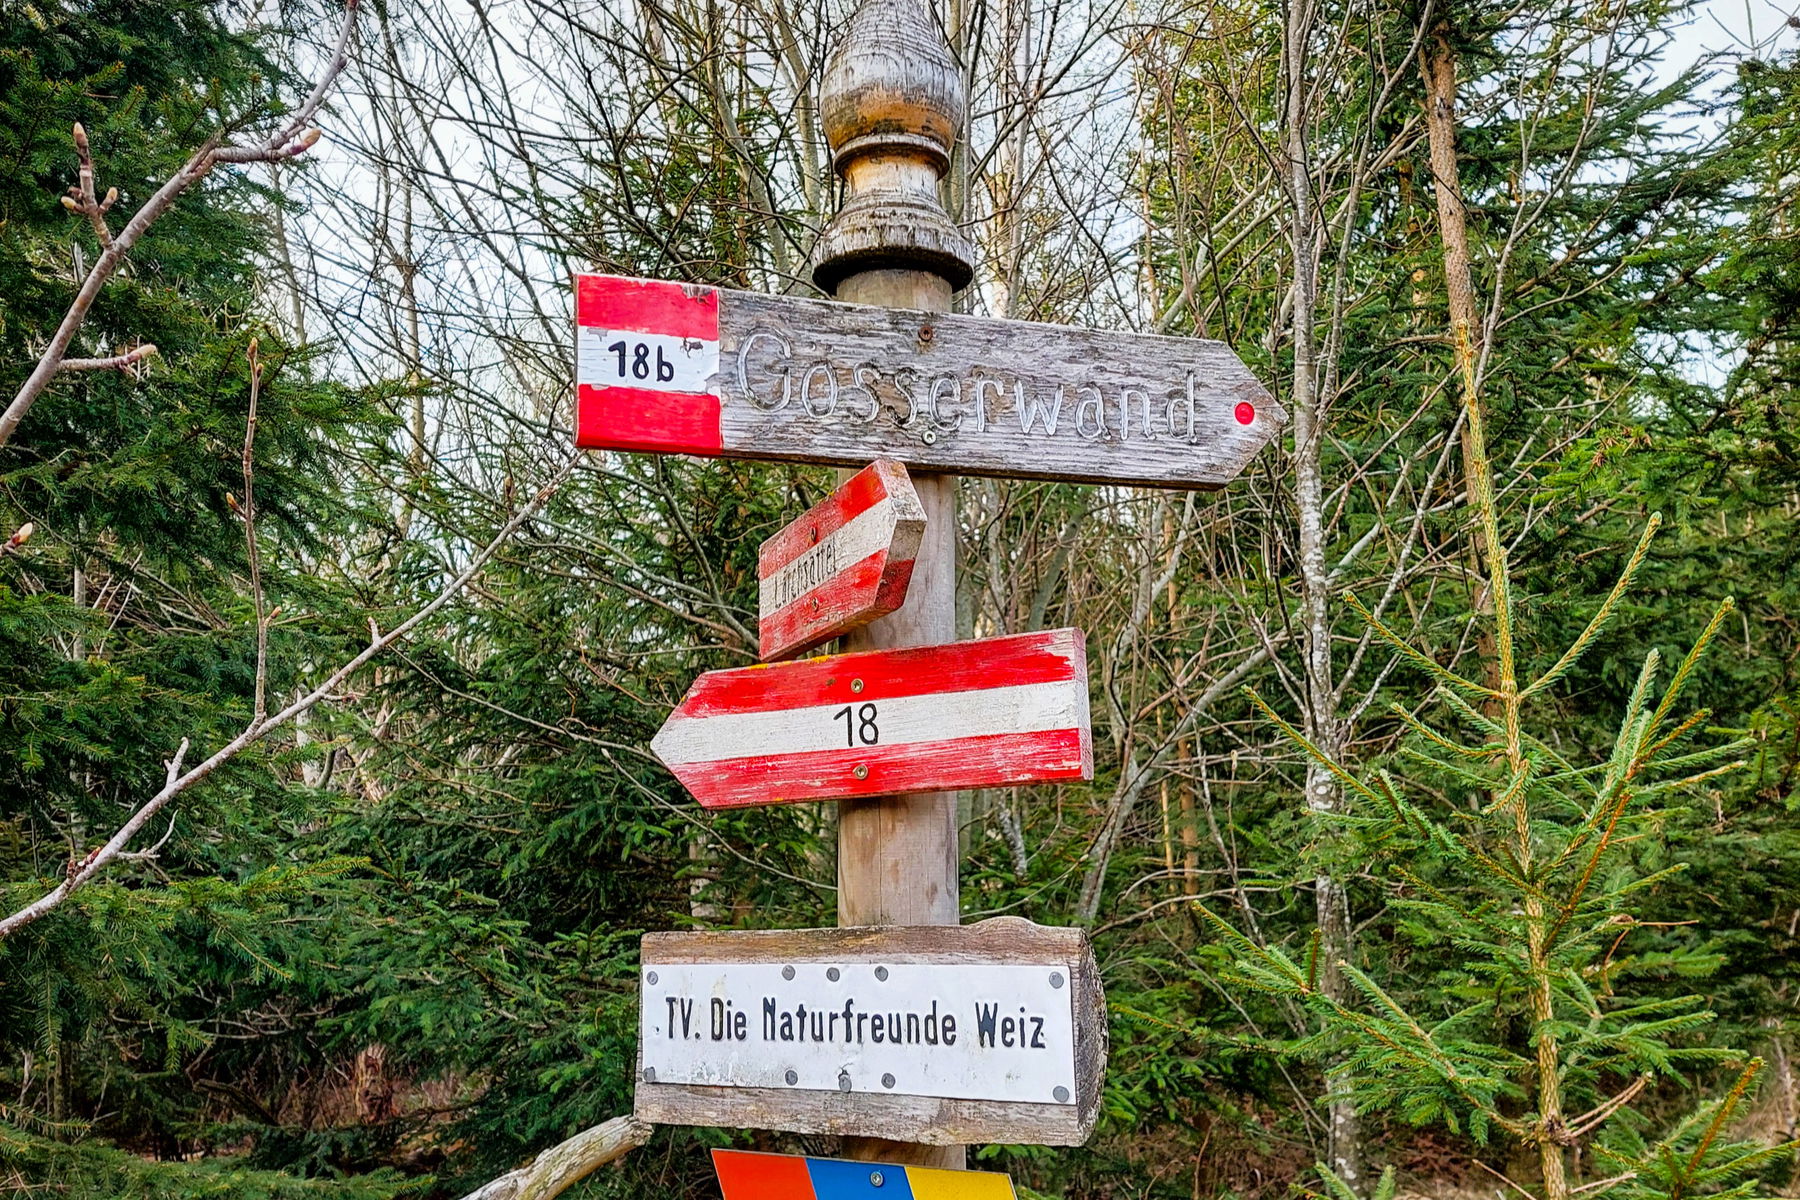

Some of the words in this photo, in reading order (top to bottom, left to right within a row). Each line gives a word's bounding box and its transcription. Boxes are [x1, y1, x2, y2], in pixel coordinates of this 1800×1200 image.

[608, 340, 675, 382] 18b
[736, 325, 1198, 445] Gösserwand
[832, 702, 880, 748] 18
[710, 996, 748, 1042] Die
[762, 996, 957, 1046] Naturfreunde
[974, 1001, 1047, 1049] Weiz
